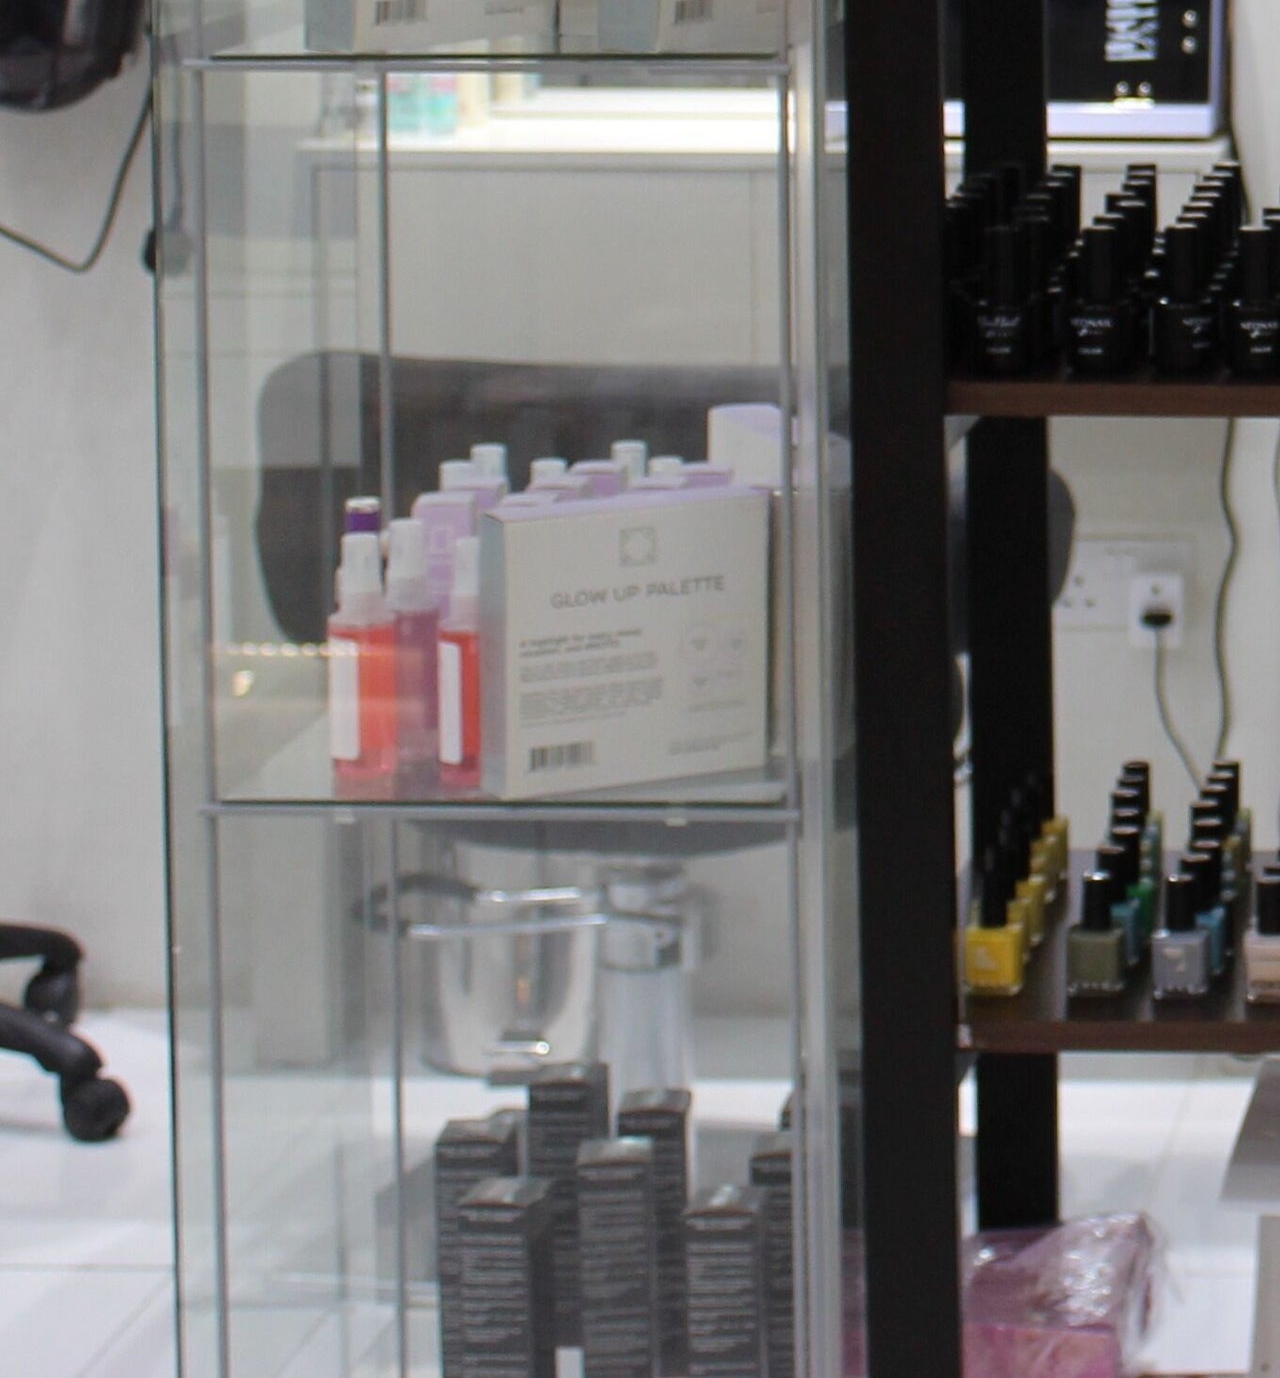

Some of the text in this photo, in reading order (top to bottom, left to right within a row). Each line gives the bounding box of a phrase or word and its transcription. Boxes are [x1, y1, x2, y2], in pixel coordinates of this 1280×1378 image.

[551, 575, 725, 610] GLOW UP PALETTE
